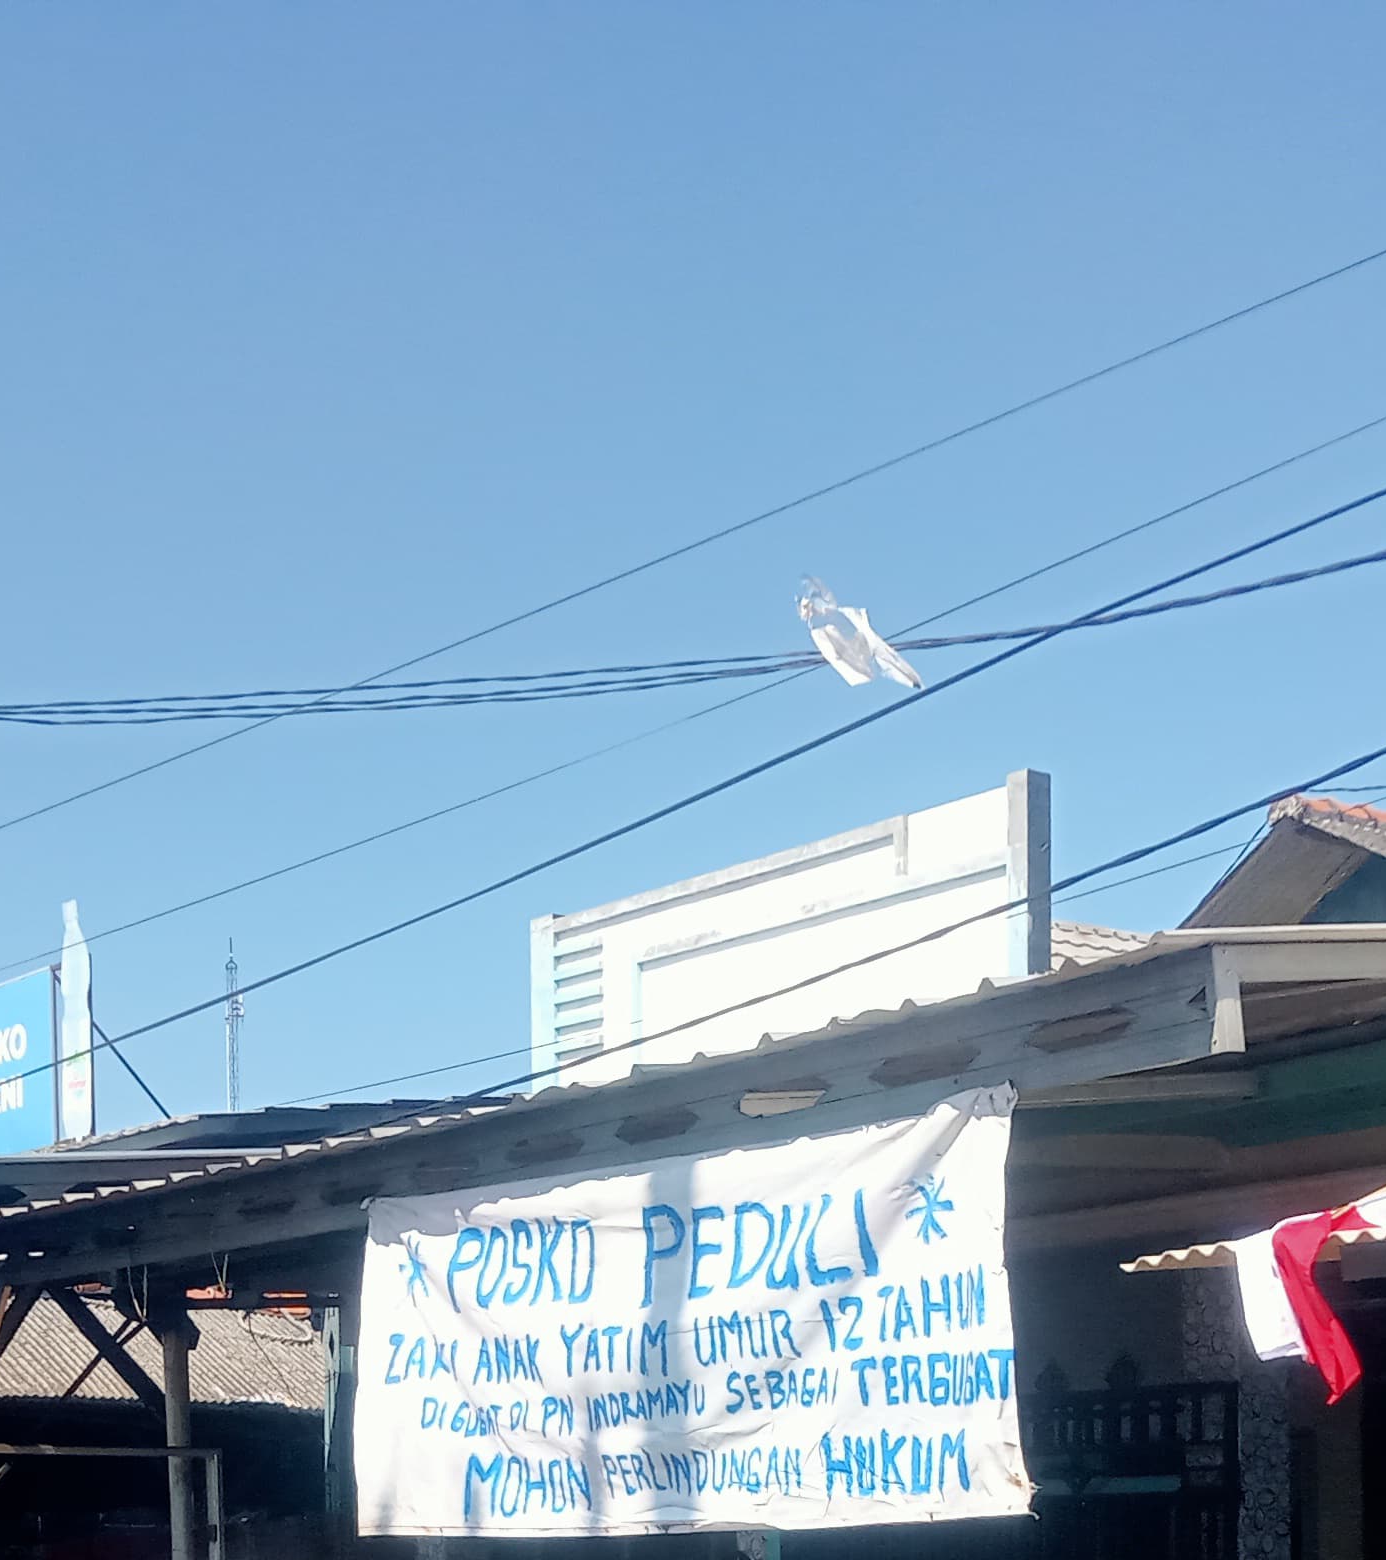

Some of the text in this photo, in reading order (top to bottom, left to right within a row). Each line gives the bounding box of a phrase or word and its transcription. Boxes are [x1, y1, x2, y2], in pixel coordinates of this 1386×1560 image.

[447, 1188, 880, 1314] POSKO PEDULI
[385, 1263, 986, 1387] ZAKI ANAK YATIM UMUR 12 TAHUN
[541, 1396, 574, 1438] PN
[585, 1379, 706, 1433] INDRAMAYU
[725, 1366, 839, 1415] SEBAGAI
[851, 1348, 1017, 1407] TERGUGAT
[463, 1428, 970, 1522] MOHON PERLINDUNGAN HUKUM
